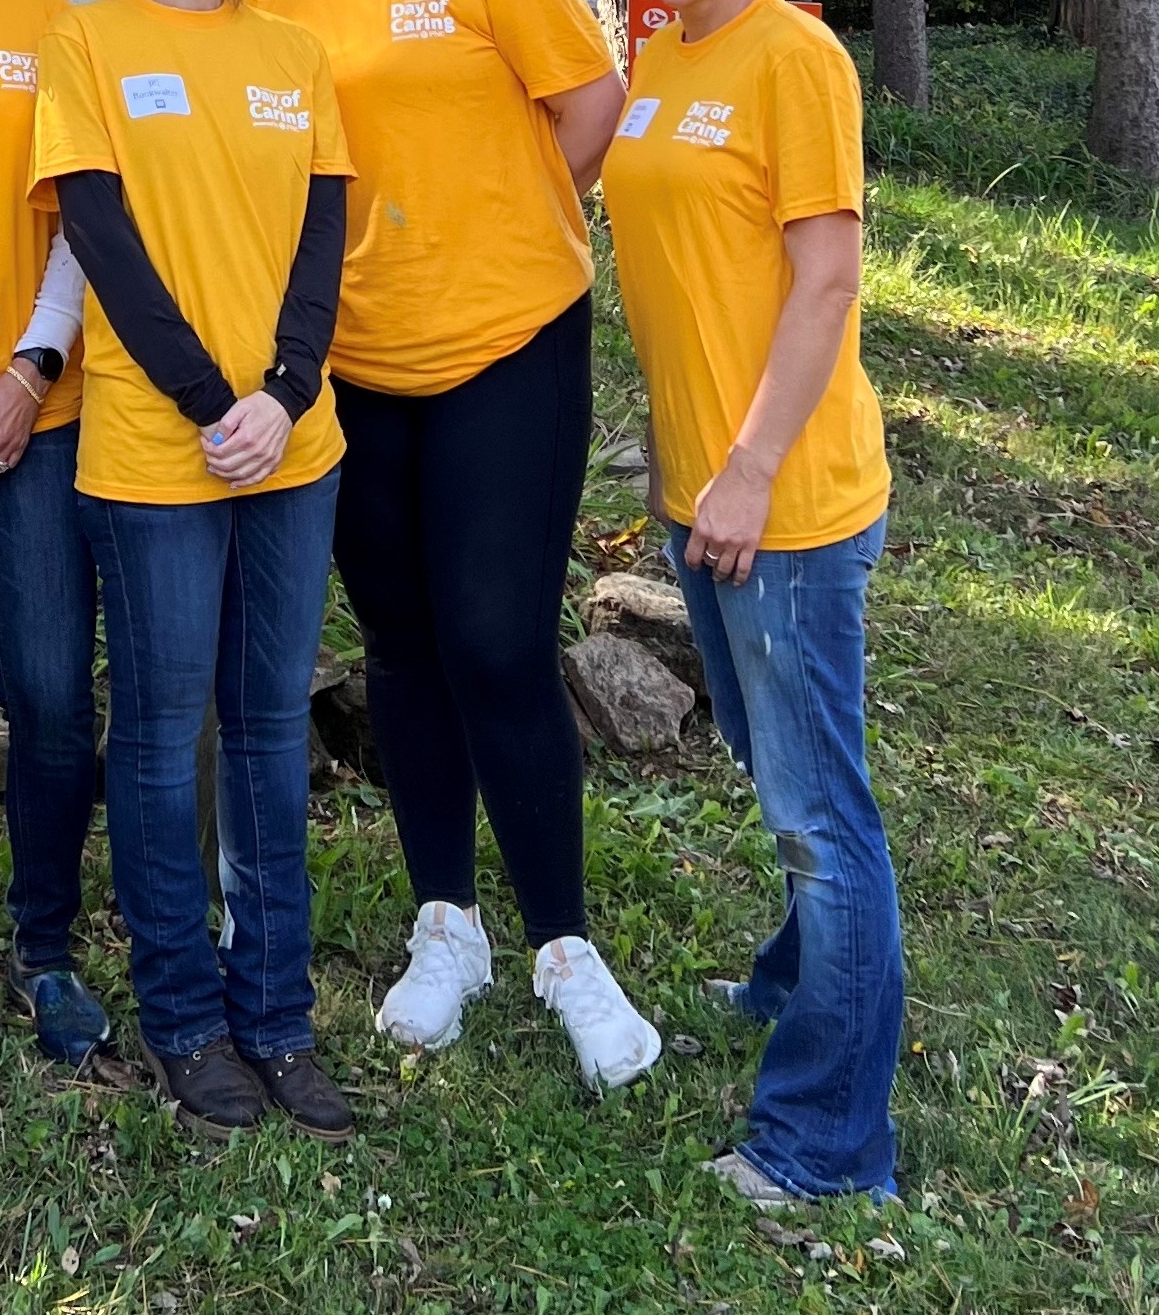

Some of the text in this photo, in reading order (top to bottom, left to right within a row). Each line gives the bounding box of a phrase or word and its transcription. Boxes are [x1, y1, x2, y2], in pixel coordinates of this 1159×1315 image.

[391, 2, 426, 18] Day
[390, 13, 456, 34] Caring
[0, 65, 37, 84] Cari
[246, 85, 301, 108] Day of
[249, 102, 310, 130] Caring
[709, 105, 734, 123] of
[677, 117, 731, 146] Caring
